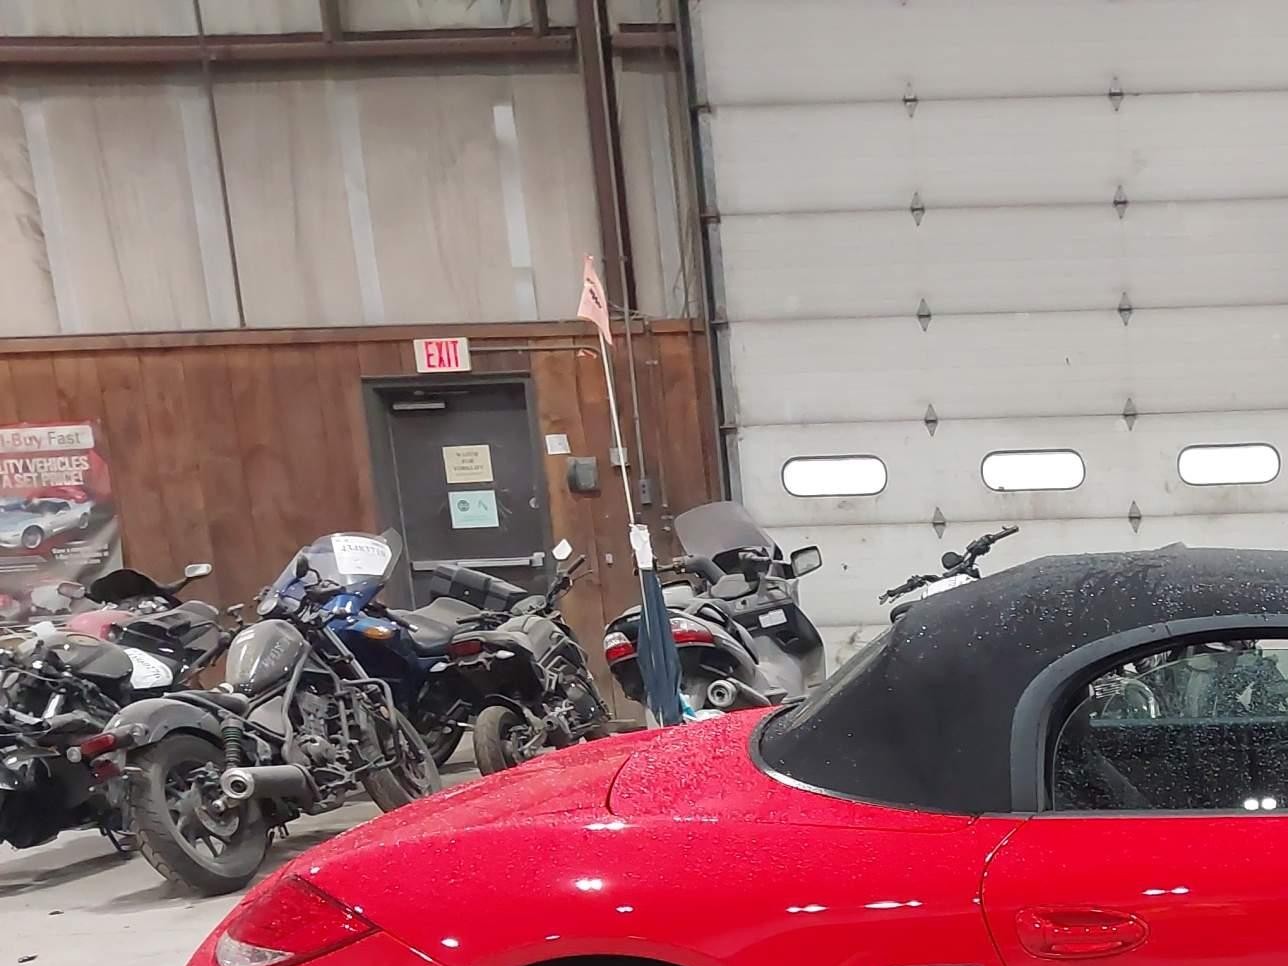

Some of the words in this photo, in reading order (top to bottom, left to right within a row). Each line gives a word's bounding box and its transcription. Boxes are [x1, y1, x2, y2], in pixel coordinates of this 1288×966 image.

[424, 340, 459, 368] EXIT
[47, 430, 81, 446] Fast
[25, 455, 89, 473] VEHICLES
[2, 473, 13, 489] A
[14, 472, 39, 488] SET
